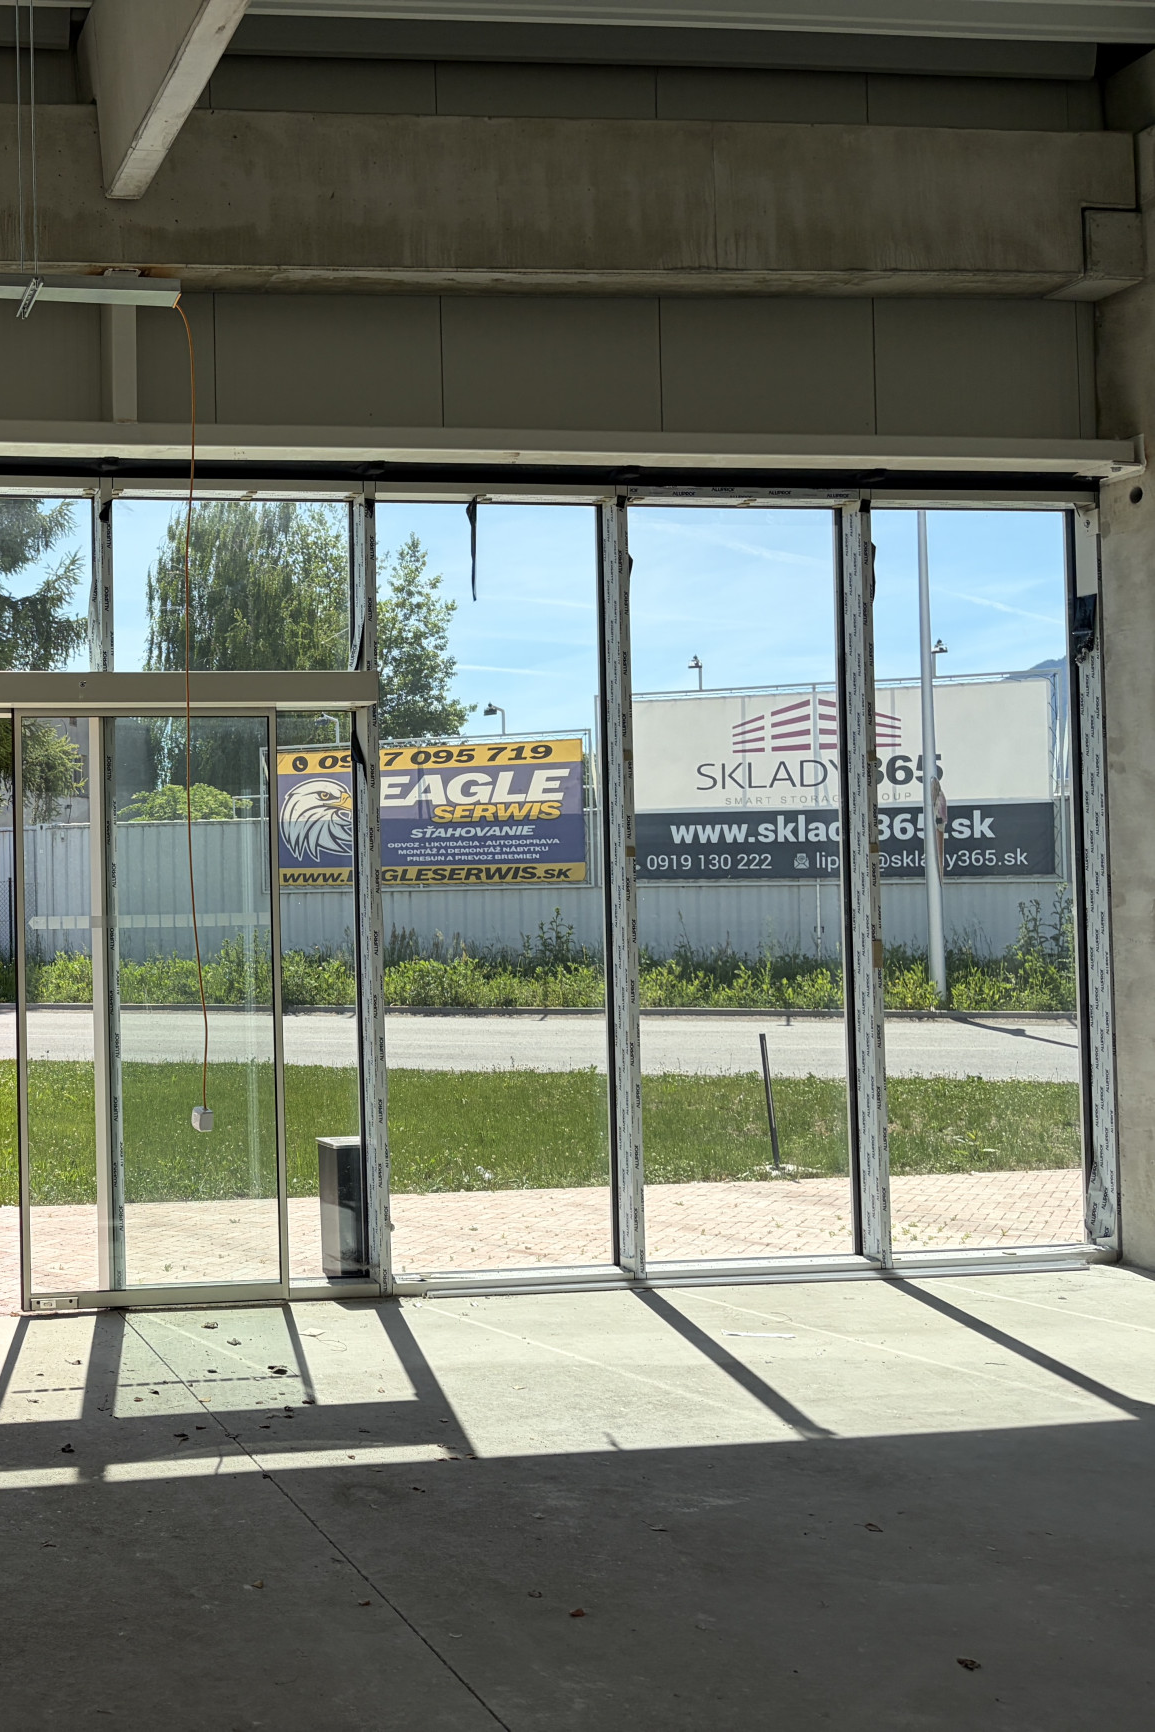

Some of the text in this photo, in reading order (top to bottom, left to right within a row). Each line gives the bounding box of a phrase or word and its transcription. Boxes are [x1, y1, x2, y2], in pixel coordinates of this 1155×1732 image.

[410, 748, 476, 765] 095
[487, 744, 553, 762] 719
[380, 768, 571, 807] EAGLE
[725, 796, 772, 806] SMART
[780, 794, 839, 804] STORAG
[431, 801, 563, 823] SERWIS
[410, 825, 536, 839] SŤAHOVANIE
[646, 854, 692, 870] 0919
[698, 854, 732, 870] 130
[736, 853, 773, 869] 222
